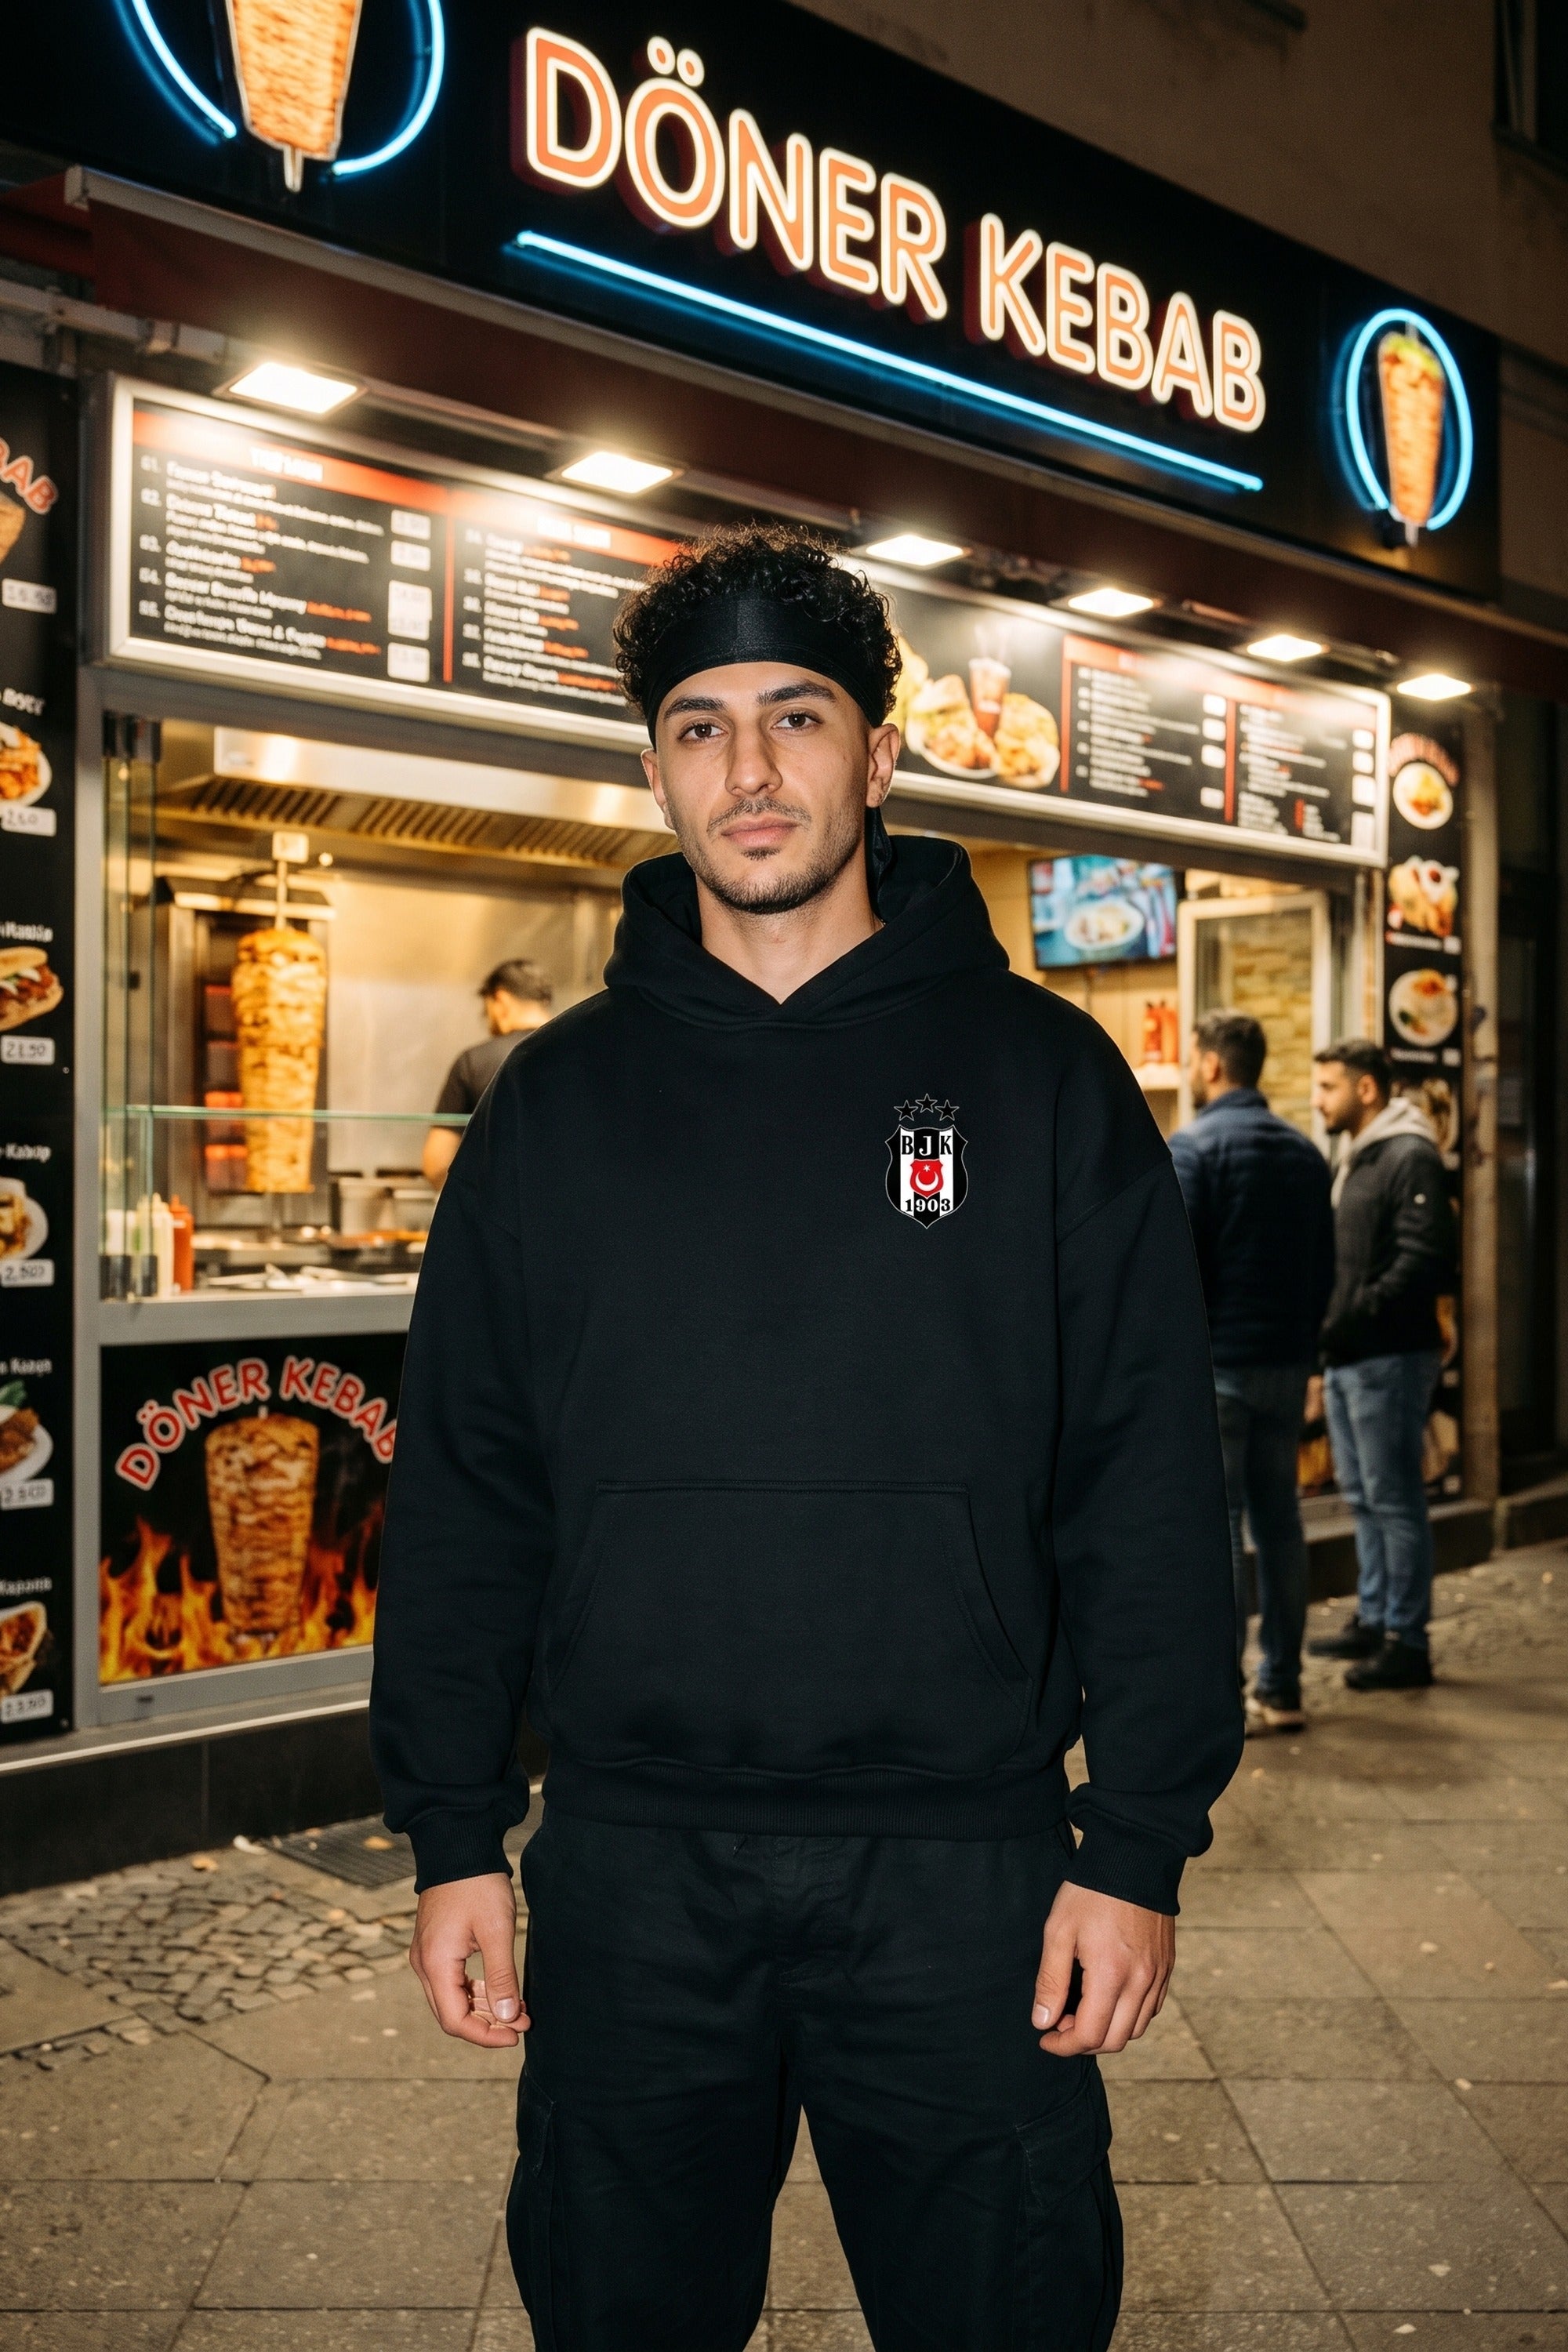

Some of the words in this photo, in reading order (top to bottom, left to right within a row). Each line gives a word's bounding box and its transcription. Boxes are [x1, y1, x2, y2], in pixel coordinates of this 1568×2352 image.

[524, 26, 949, 320] DÖNER
[978, 212, 1267, 433] KEBAB
[901, 1134, 953, 1156] BJK
[905, 1199, 951, 1213] 1903
[115, 1357, 271, 1490] DÖNER
